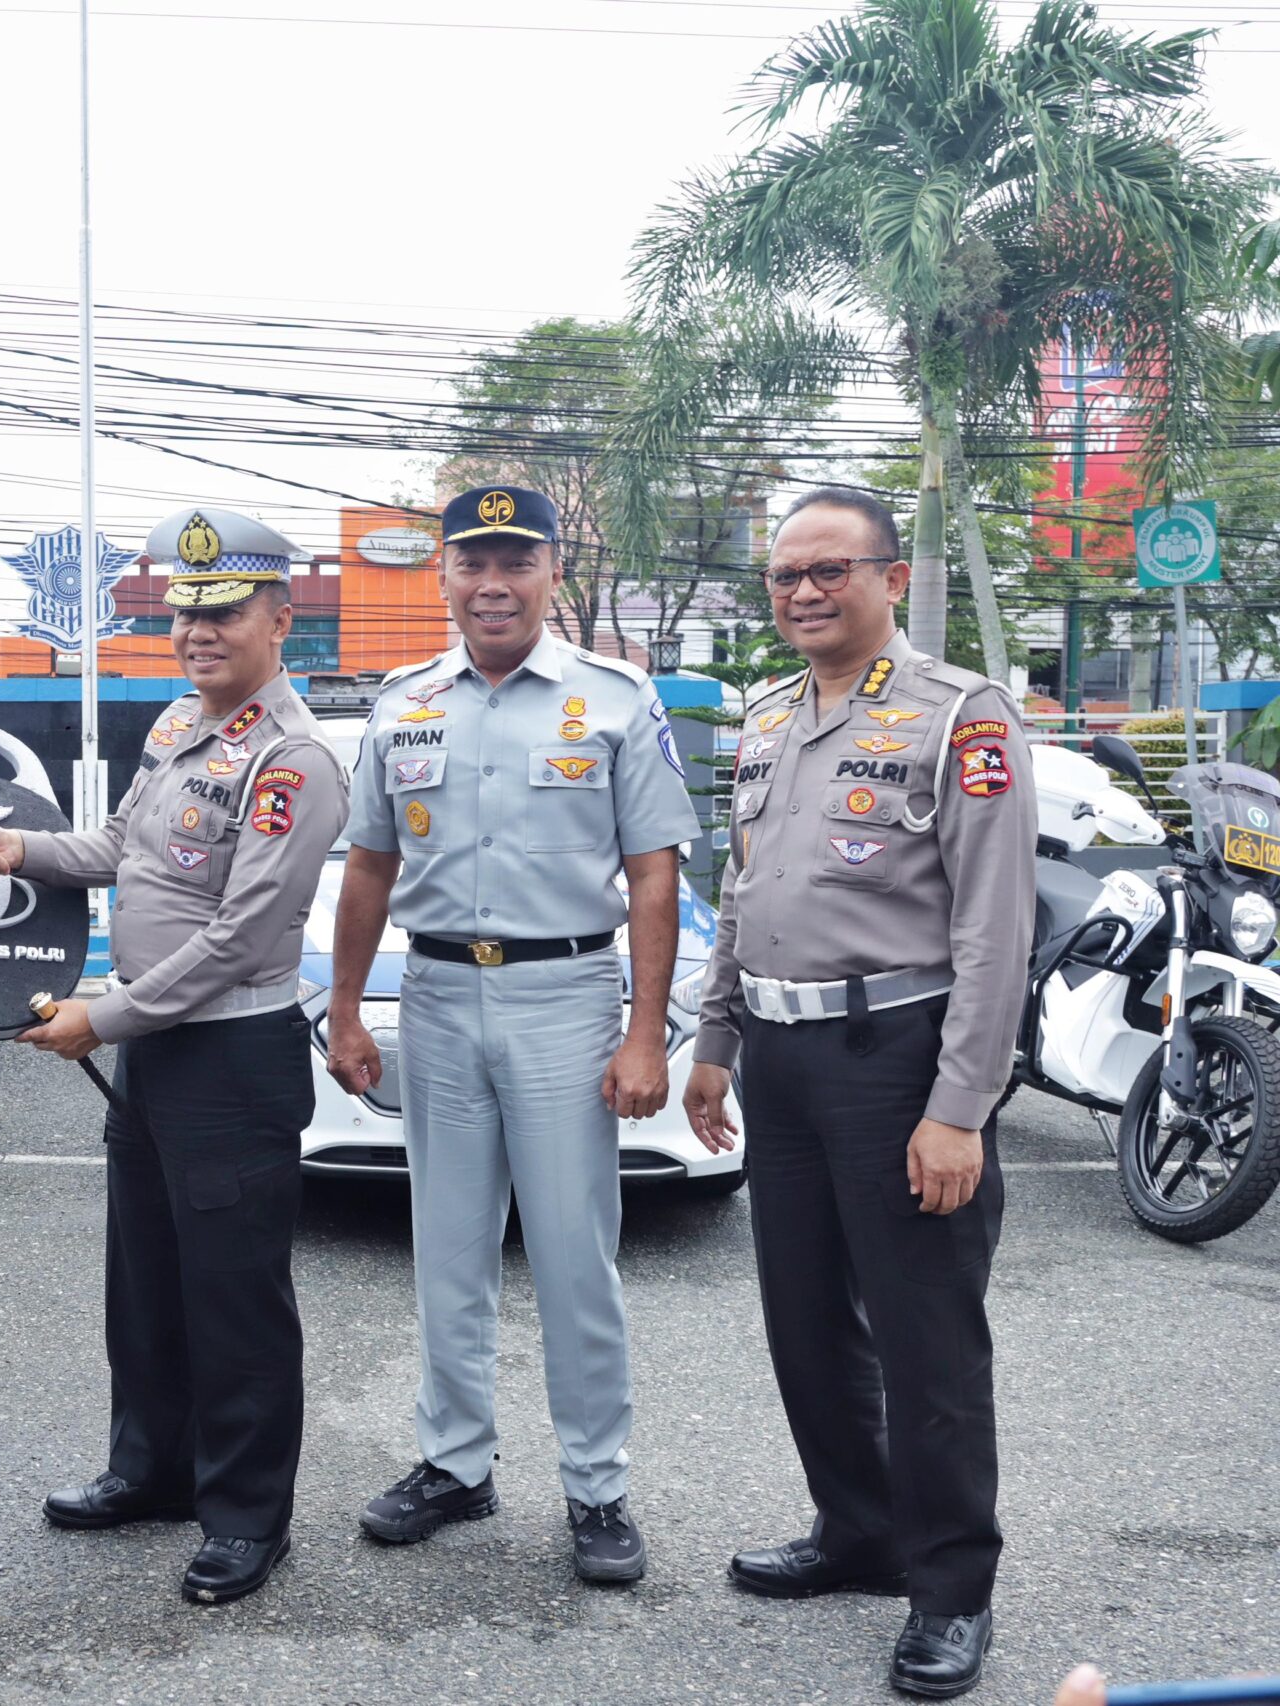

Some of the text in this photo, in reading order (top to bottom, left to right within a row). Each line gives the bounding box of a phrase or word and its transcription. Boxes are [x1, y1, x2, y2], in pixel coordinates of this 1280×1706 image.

[1165, 508, 1211, 538] ERKUMPUL
[1186, 552, 1208, 575] POINT
[393, 729, 444, 748] RIVAN
[951, 722, 1006, 743] KORLANTAS
[256, 770, 300, 786] KORLANTAS
[836, 759, 909, 785] POLRI
[987, 770, 1008, 781] POLRI
[181, 776, 231, 807] POLRI
[1118, 881, 1136, 898] ZERO
[14, 944, 66, 963] POLRI
